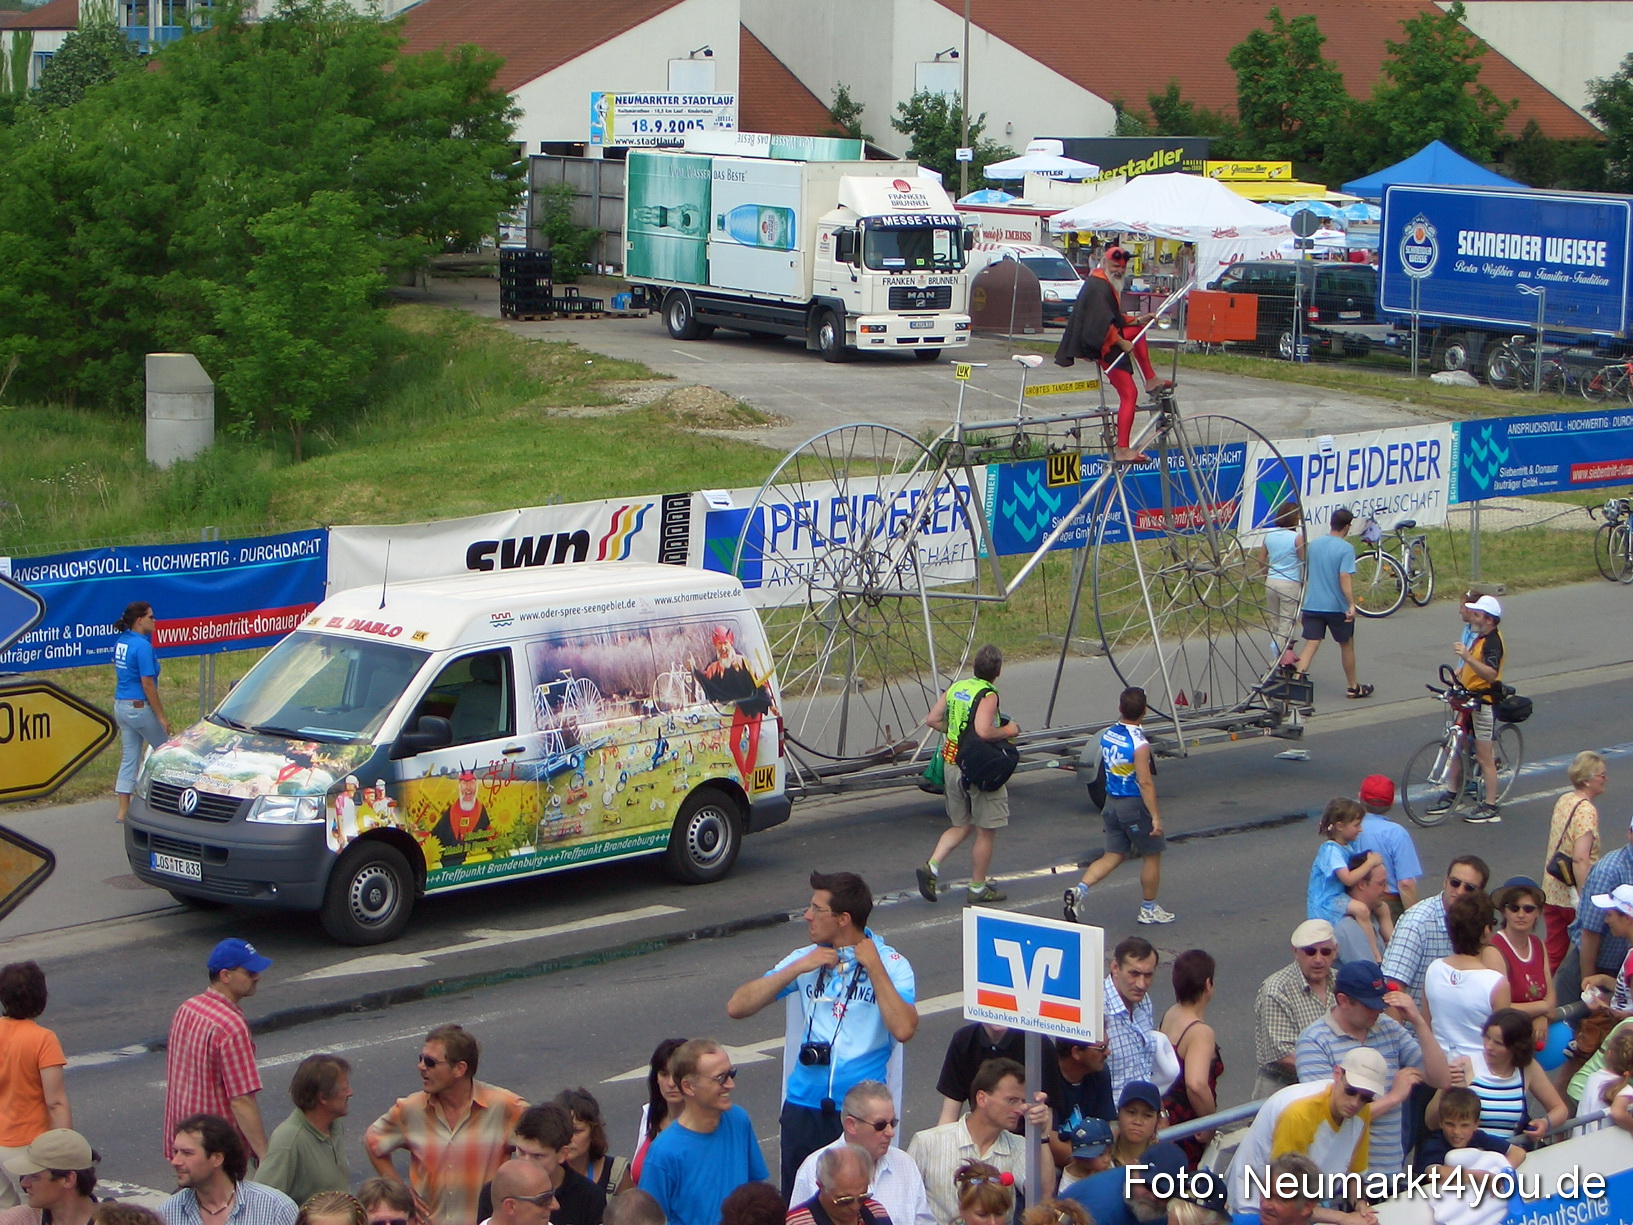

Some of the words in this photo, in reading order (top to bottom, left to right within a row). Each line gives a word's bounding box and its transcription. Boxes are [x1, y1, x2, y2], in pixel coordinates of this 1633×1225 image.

[615, 96, 679, 105] NEUMARKTER
[682, 96, 734, 105] STADTLAUF
[632, 119, 705, 133] 18.9.2005
[882, 215, 957, 226] MESSE-TEAM
[1005, 230, 1032, 241] IMBISS
[1457, 230, 1542, 262] SCHNEIDER
[1545, 237, 1607, 267] WEISSE
[882, 277, 916, 286] FRANKEN
[928, 276, 959, 285] BRUNNEN
[1453, 260, 1478, 274] Bestes
[1482, 263, 1514, 278] Weißbier
[1518, 270, 1531, 278] aus
[1534, 267, 1609, 287] Familien-Tradition
[907, 291, 935, 299] MAN
[1074, 382, 1085, 391] DER
[1508, 420, 1563, 435] ANSPRUCHSVOLL
[1567, 416, 1609, 430] HOCHWERTIG
[1306, 439, 1441, 497] PFLEIDERER
[12, 557, 132, 582] ANSPRUCHSVOLL
[142, 550, 230, 572] HOCHWERTIG
[240, 538, 322, 563] DURCHDACHT
[466, 529, 590, 571] swn
[520, 599, 636, 621] www.oder-spree-seengebiet.de
[654, 588, 742, 606] www.scharmuetzelsee.de
[63, 626, 72, 639] &
[325, 616, 345, 628] EL
[345, 619, 403, 638] DIABLO
[45, 642, 82, 659] GmbH
[19, 707, 50, 741] km
[155, 855, 169, 870] LOS
[174, 859, 185, 873] TE
[186, 861, 200, 876] 833
[968, 1006, 1018, 1023] Volksbanken
[1021, 1017, 1092, 1037] Raiffeisenbanken
